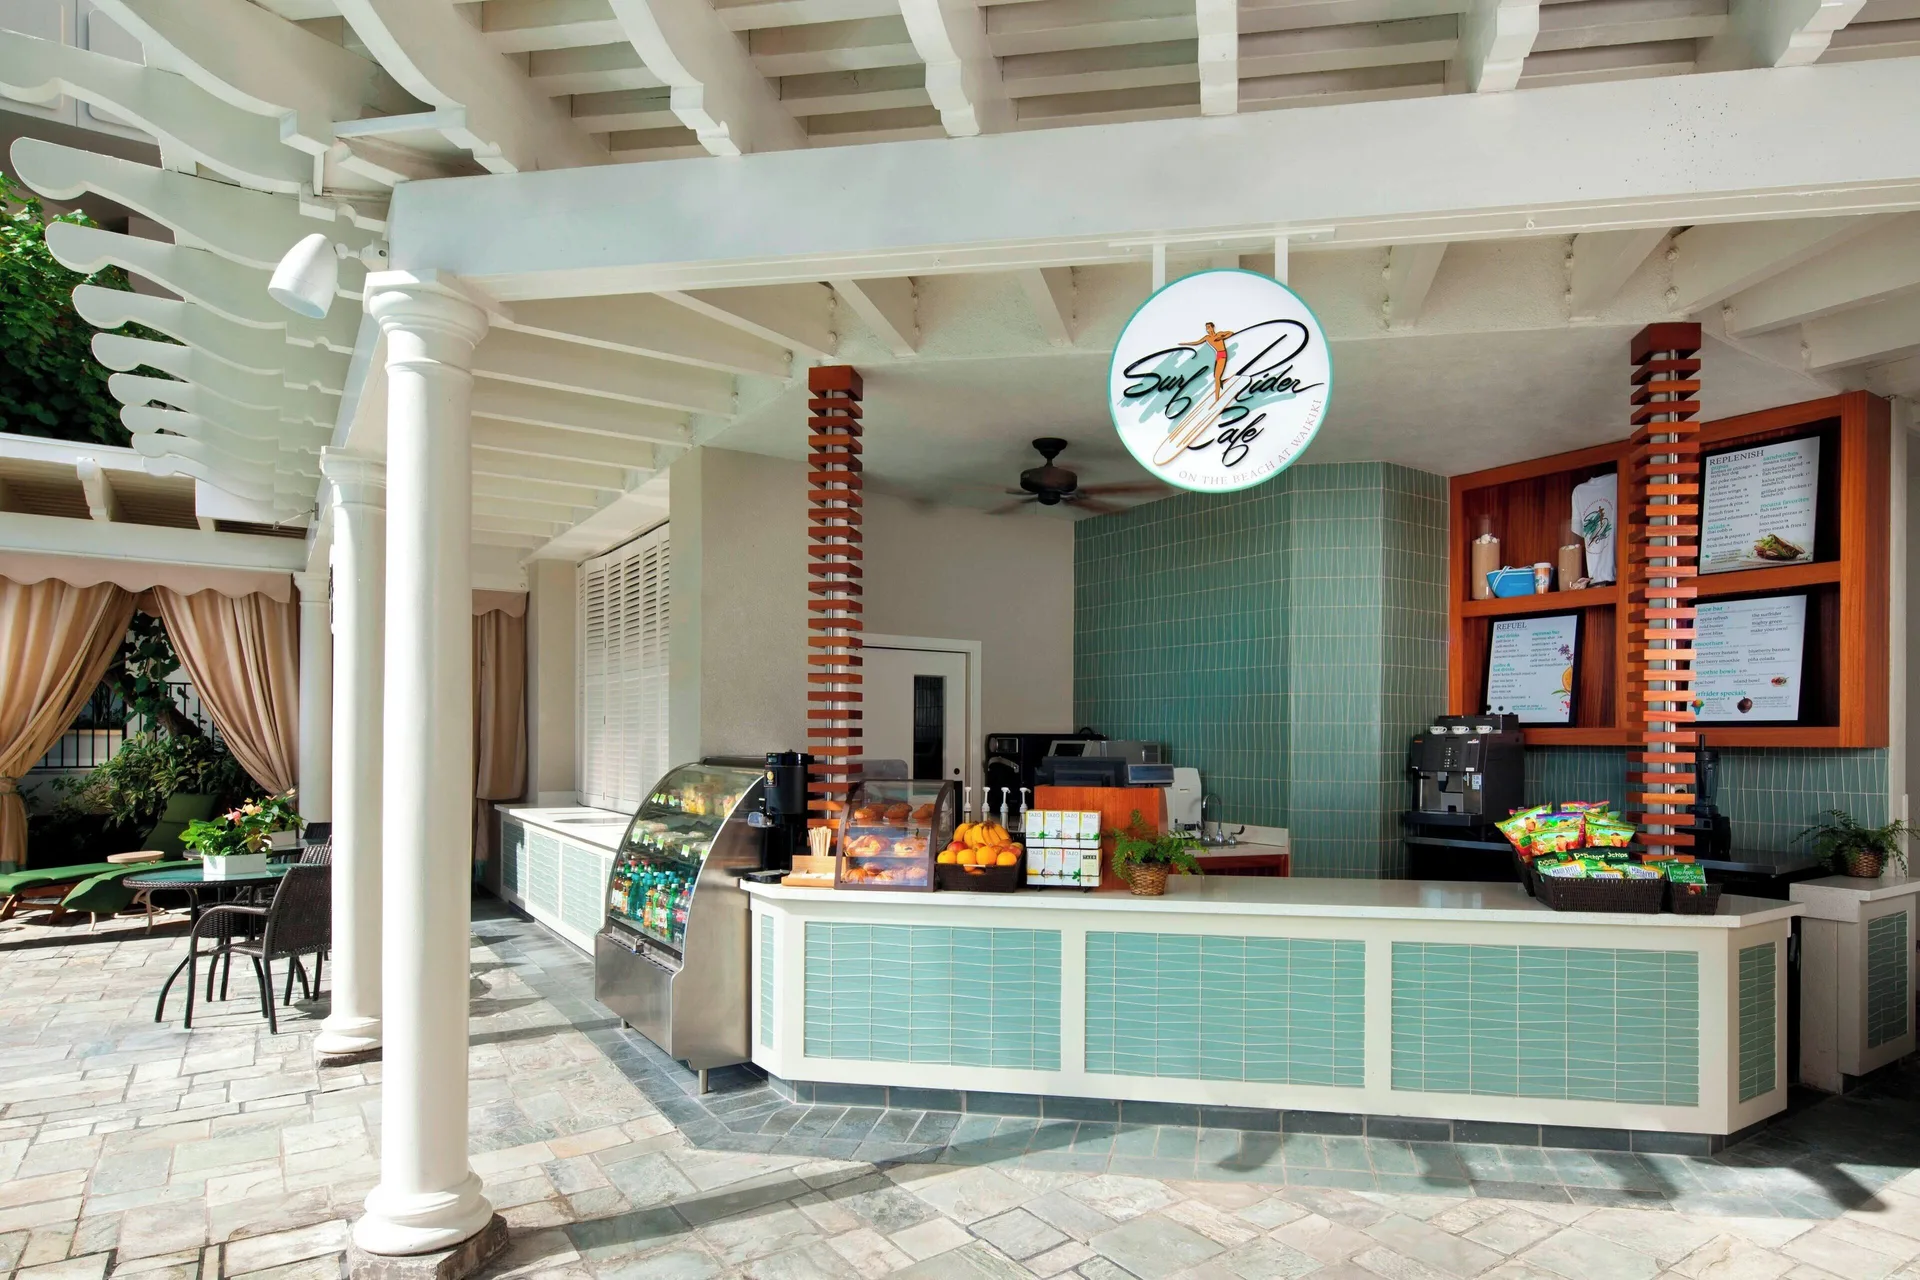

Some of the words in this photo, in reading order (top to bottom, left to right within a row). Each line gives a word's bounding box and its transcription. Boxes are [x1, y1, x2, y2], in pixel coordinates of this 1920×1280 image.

[1123, 346, 1209, 420] Surf
[1231, 319, 1325, 402] Rider
[1178, 469, 1197, 484] ON
[1201, 474, 1228, 486] THE
[1233, 460, 1277, 485] BEACH
[1278, 448, 1292, 464] AT
[1291, 399, 1323, 452] WAIKIKI
[1187, 405, 1267, 468] Cafe
[1709, 449, 1764, 466] REPLENISH
[1763, 451, 1799, 461] sandwiches
[1782, 497, 1810, 505] favorites
[1496, 621, 1528, 630] REFUEL
